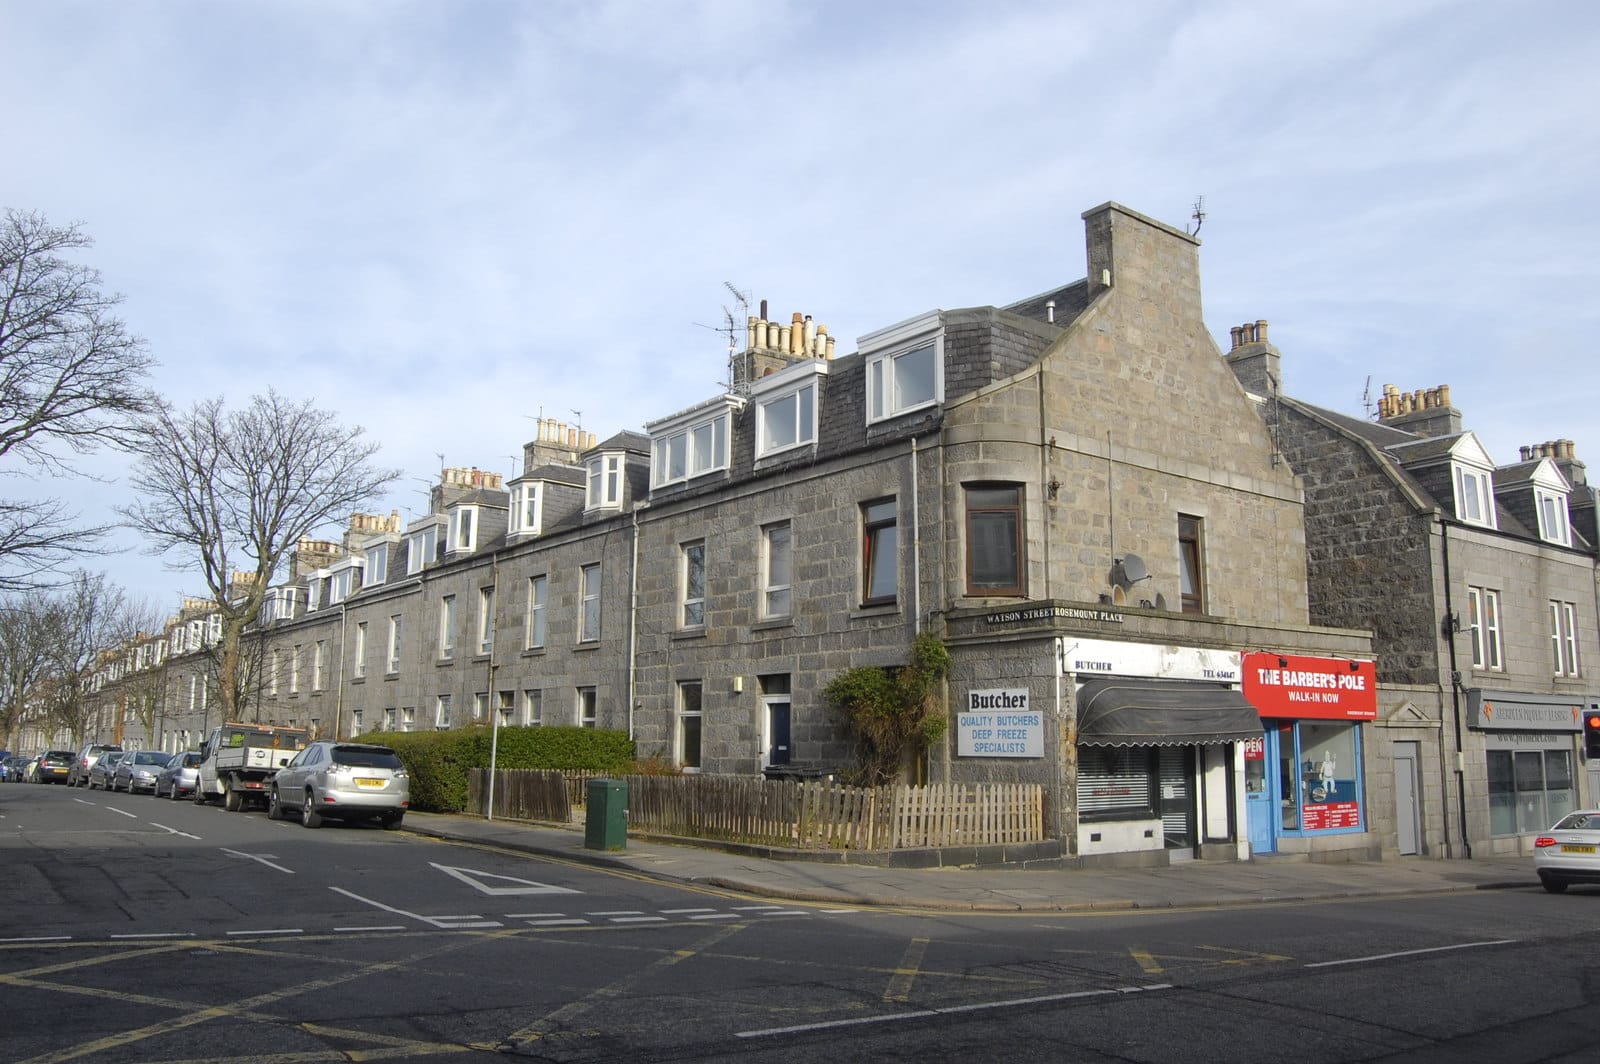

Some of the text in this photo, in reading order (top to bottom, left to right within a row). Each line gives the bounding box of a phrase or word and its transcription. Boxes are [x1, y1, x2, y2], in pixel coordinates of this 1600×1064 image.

[987, 607, 1054, 623] WATSON STREET
[1055, 607, 1123, 622] ROSEMOUNT PLACE
[1075, 660, 1112, 671] BUTCHER
[1203, 669, 1214, 678] TEL
[1258, 668, 1365, 690] THE BARBER'S POLE
[971, 692, 1026, 709] Butcher
[1288, 691, 1339, 704] WALK-IN NOW
[961, 715, 1039, 726] QUALITY BUTCHERS
[972, 729, 1027, 739] DEEP FREEZE
[974, 742, 1026, 753] SPECIALISTS
[1245, 740, 1262, 752] PEN
